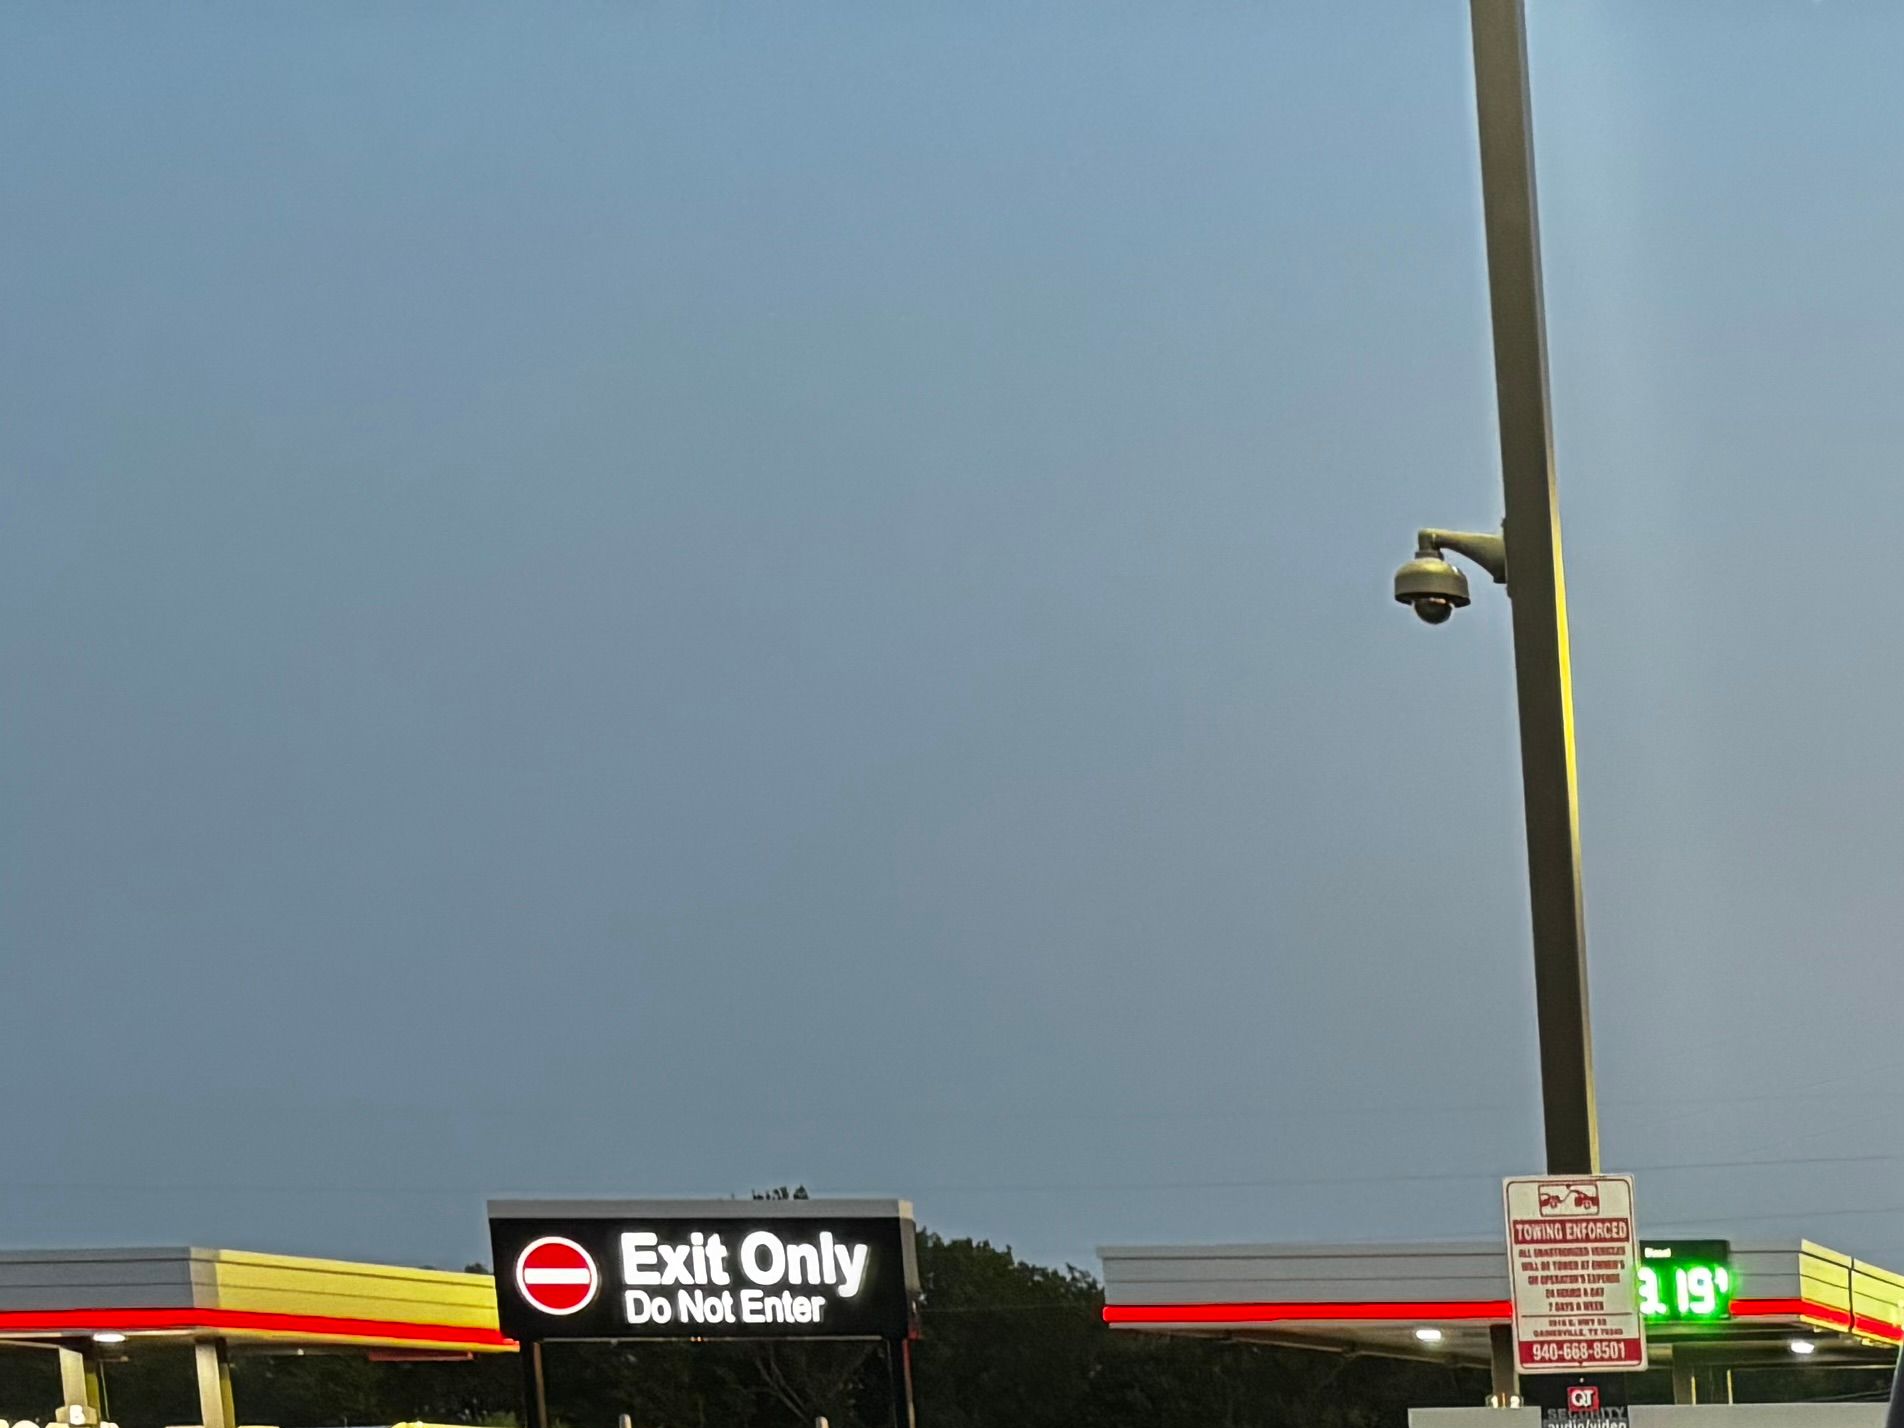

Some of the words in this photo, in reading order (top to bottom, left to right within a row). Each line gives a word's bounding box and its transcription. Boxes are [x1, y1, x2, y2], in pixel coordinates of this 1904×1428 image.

[1515, 1223, 1563, 1241] TOWING
[1565, 1221, 1627, 1240] ENFORCED
[1519, 1249, 1531, 1258] ALL
[1591, 1246, 1626, 1256] VEHICLES
[621, 1231, 730, 1286] Exit
[741, 1231, 868, 1297] Only
[1521, 1262, 1539, 1271] WILL
[1541, 1261, 1550, 1271] BE
[1553, 1261, 1579, 1271] TOWED
[1580, 1260, 1590, 1270] AT
[1546, 1289, 1555, 1298] 24
[1557, 1288, 1582, 1298] HOURS
[1583, 1288, 1589, 1297] A
[1590, 1287, 1604, 1297] DAY
[625, 1289, 672, 1324] Do
[678, 1289, 736, 1324] Not
[740, 1289, 826, 1323] Enter
[1555, 1302, 1574, 1312] DAYS
[1576, 1302, 1581, 1311] A
[1583, 1301, 1604, 1311] WEEK
[1588, 1328, 1599, 1337] TX
[1532, 1341, 1626, 1361] 940-668-8501
[1571, 1389, 1594, 1408] QT
